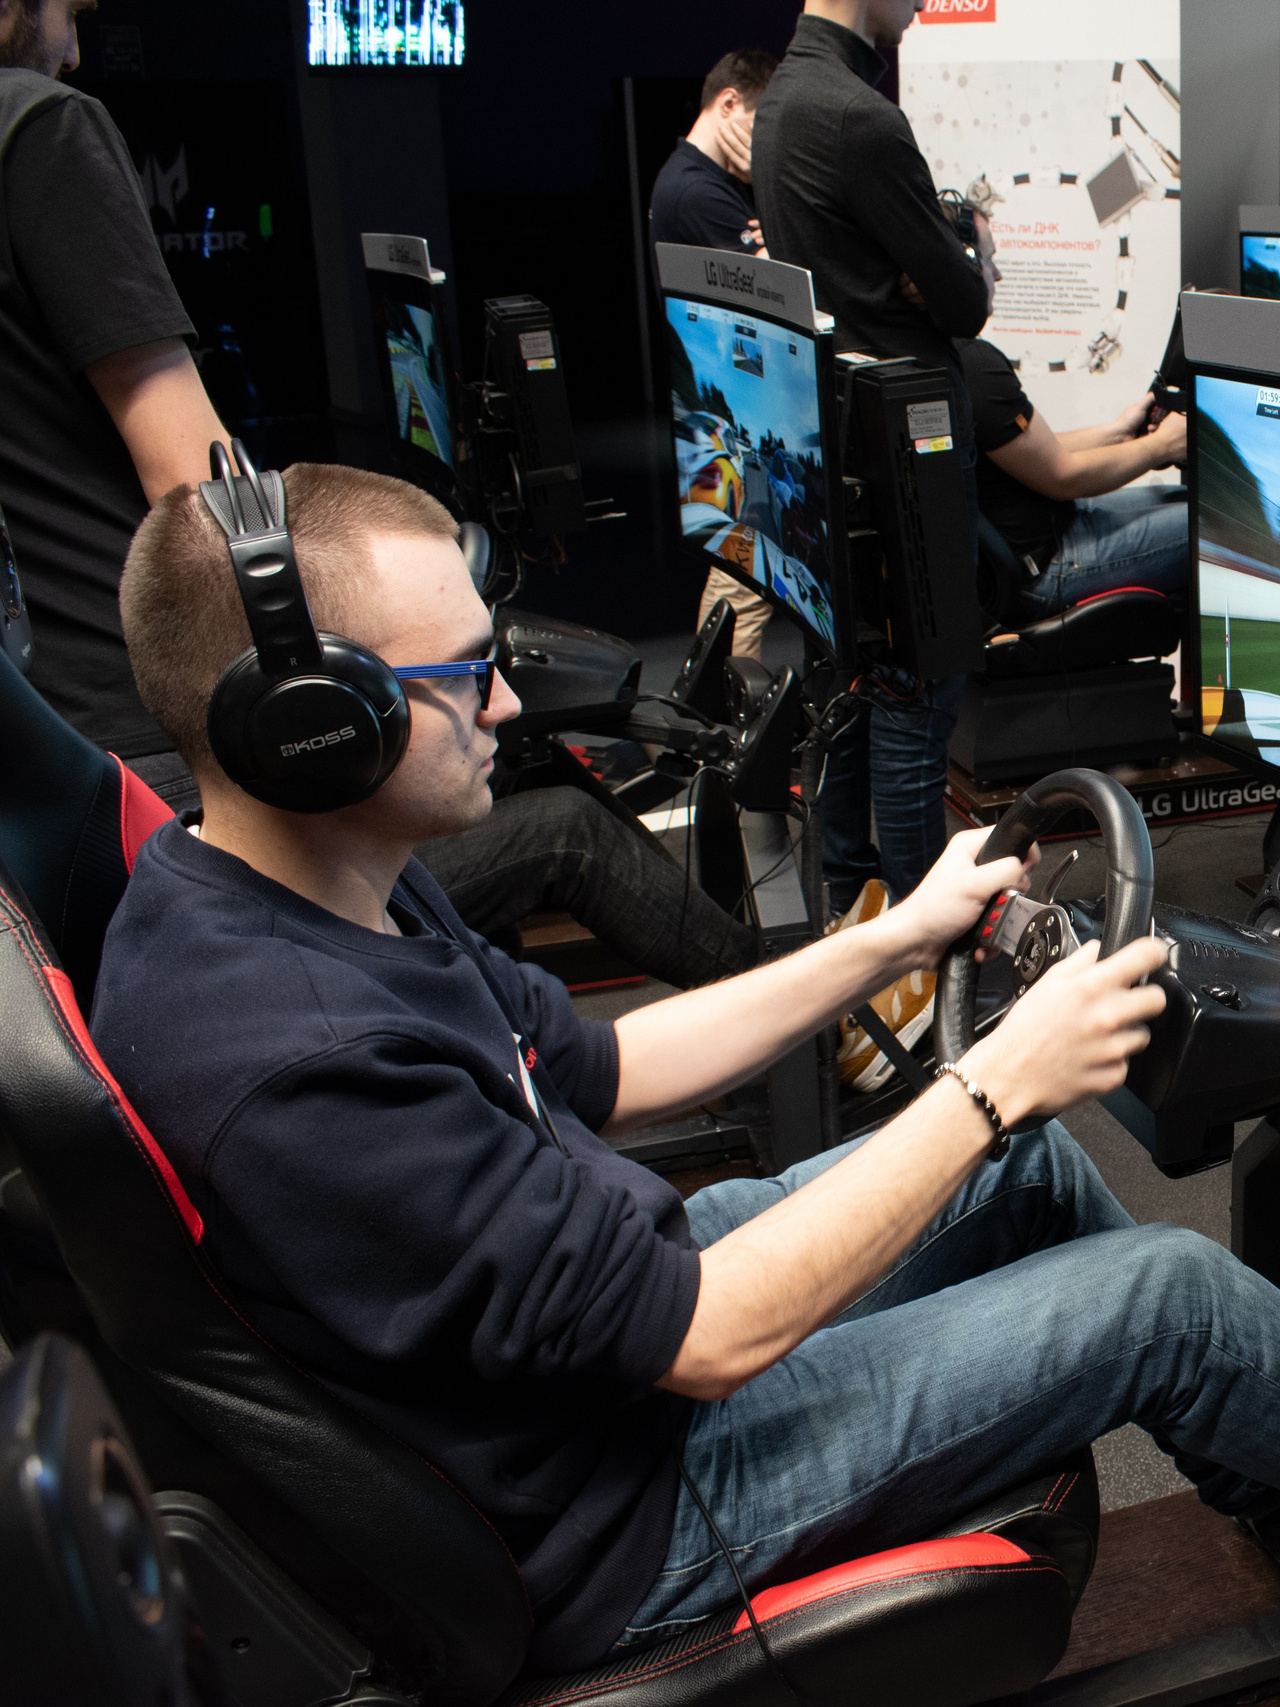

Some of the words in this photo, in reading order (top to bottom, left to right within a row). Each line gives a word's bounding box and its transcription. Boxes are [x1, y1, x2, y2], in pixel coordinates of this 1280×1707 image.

[925, 0, 989, 13] DENSO
[991, 221, 1015, 234] Есть
[1034, 221, 1060, 235] ДНК
[155, 231, 249, 252] ATOR
[704, 260, 718, 287] LG
[289, 657, 298, 667] R
[293, 725, 356, 754] KOSS
[1137, 793, 1172, 818] LG
